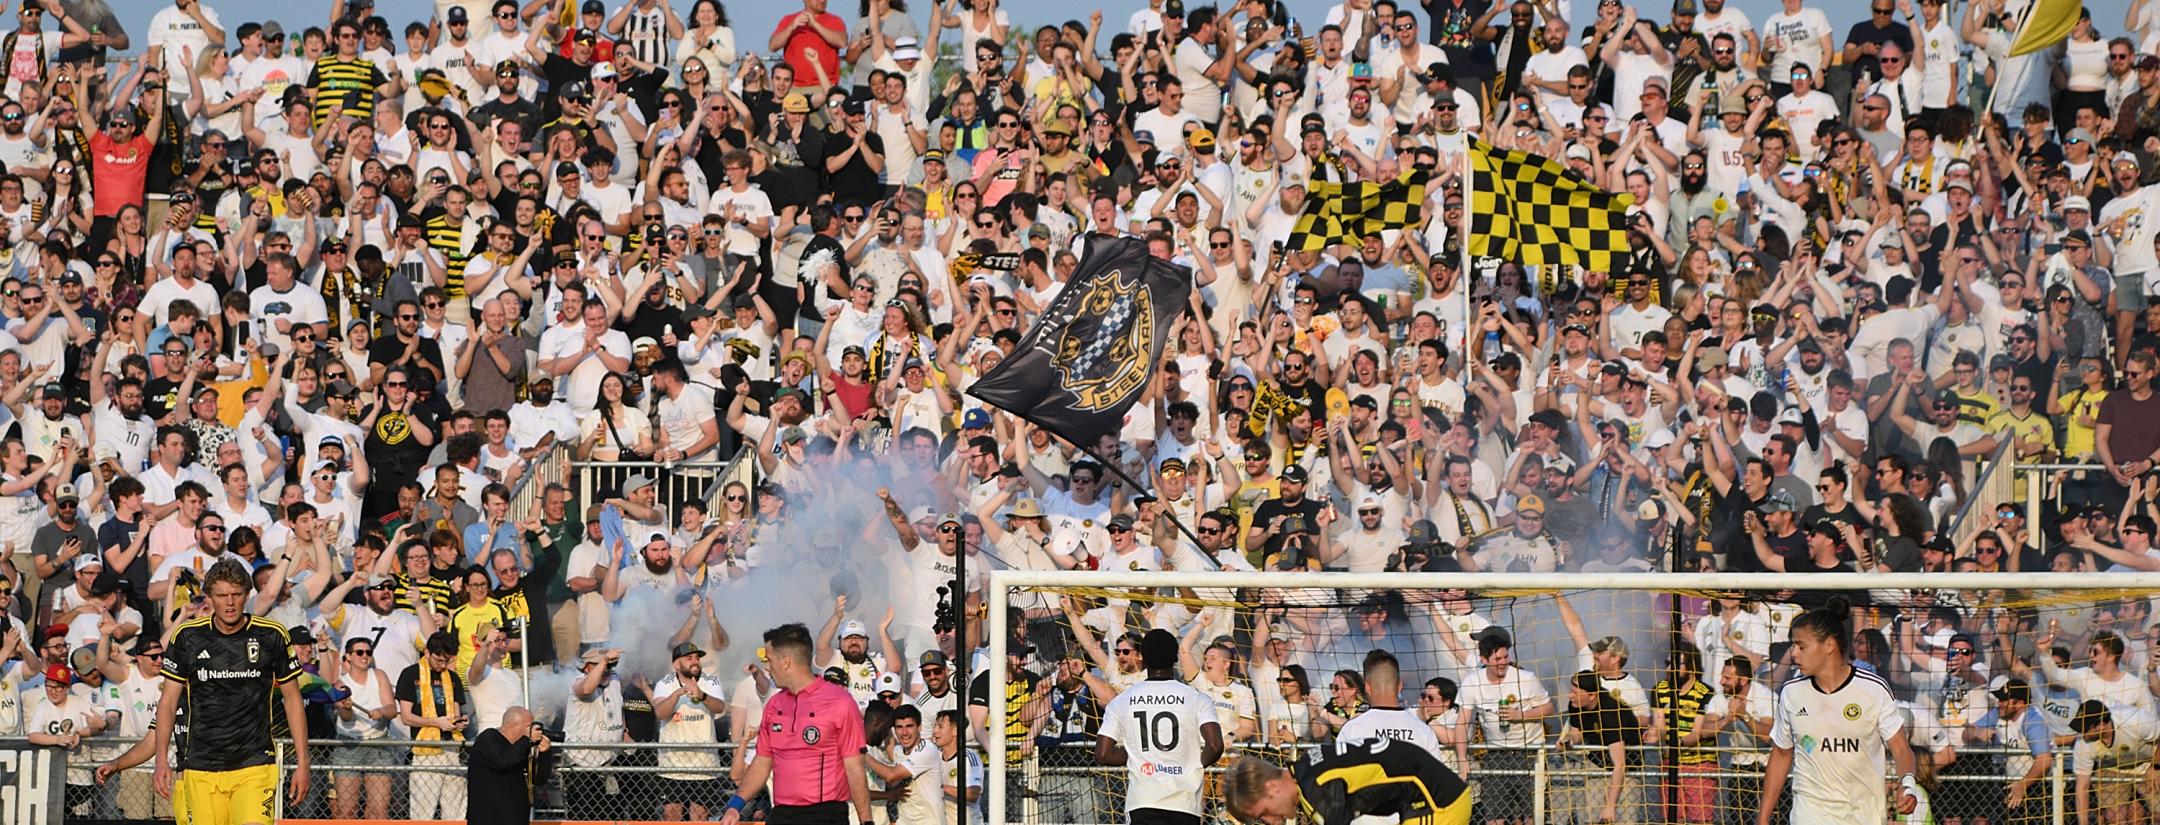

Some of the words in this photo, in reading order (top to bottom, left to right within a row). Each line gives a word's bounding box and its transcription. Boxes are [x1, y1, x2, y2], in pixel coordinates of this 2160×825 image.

[1474, 256, 1503, 270] Jeep
[1099, 360, 1147, 407] STEEL
[1138, 295, 1152, 352] ARMY
[370, 626, 388, 651] 7
[208, 668, 261, 680] Nationwide
[1129, 695, 1185, 706] HARMON
[1133, 710, 1179, 753] 10
[1374, 728, 1414, 742] MERTZ
[1820, 737, 1860, 753] AHN
[1154, 765, 1183, 776] LUMBER
